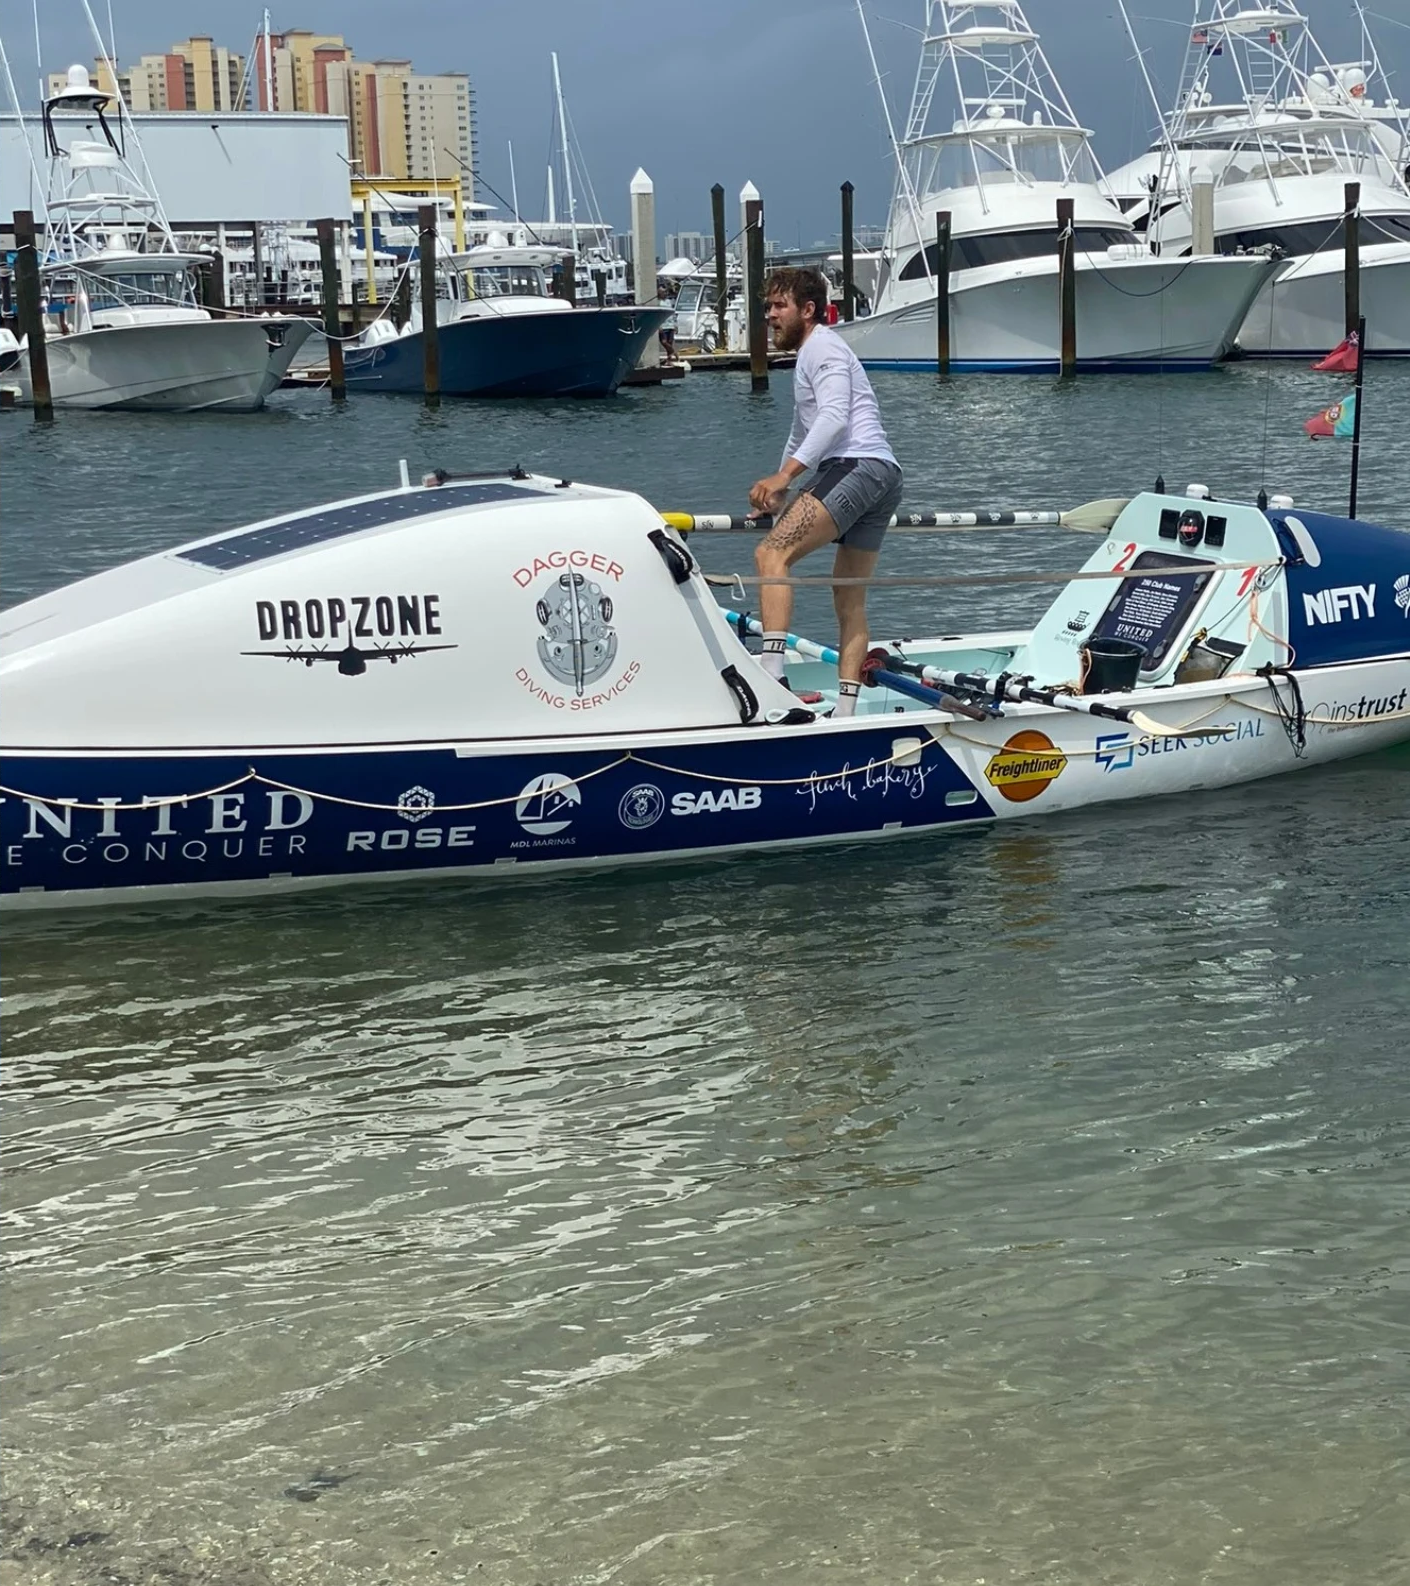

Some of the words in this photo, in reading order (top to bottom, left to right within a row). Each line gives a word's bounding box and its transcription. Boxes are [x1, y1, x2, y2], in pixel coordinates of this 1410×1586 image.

[512, 550, 624, 588] DAGGER
[1110, 543, 1137, 572] 2
[255, 594, 442, 641] DROPZONE
[1302, 583, 1376, 627] NIFTY
[1116, 623, 1154, 638] UNITED
[515, 667, 565, 709] DIVING
[570, 660, 641, 711] SERVICES
[861, 757, 938, 799] bakery
[989, 757, 1064, 779] Freightliner
[632, 788, 655, 798] SAAB
[670, 786, 762, 816] SAAB
[0, 790, 315, 839] NITED
[62, 835, 307, 864] CONQUER
[346, 825, 477, 851] ROSE
[510, 841, 531, 849] MDL
[532, 837, 577, 847] MARINAS
